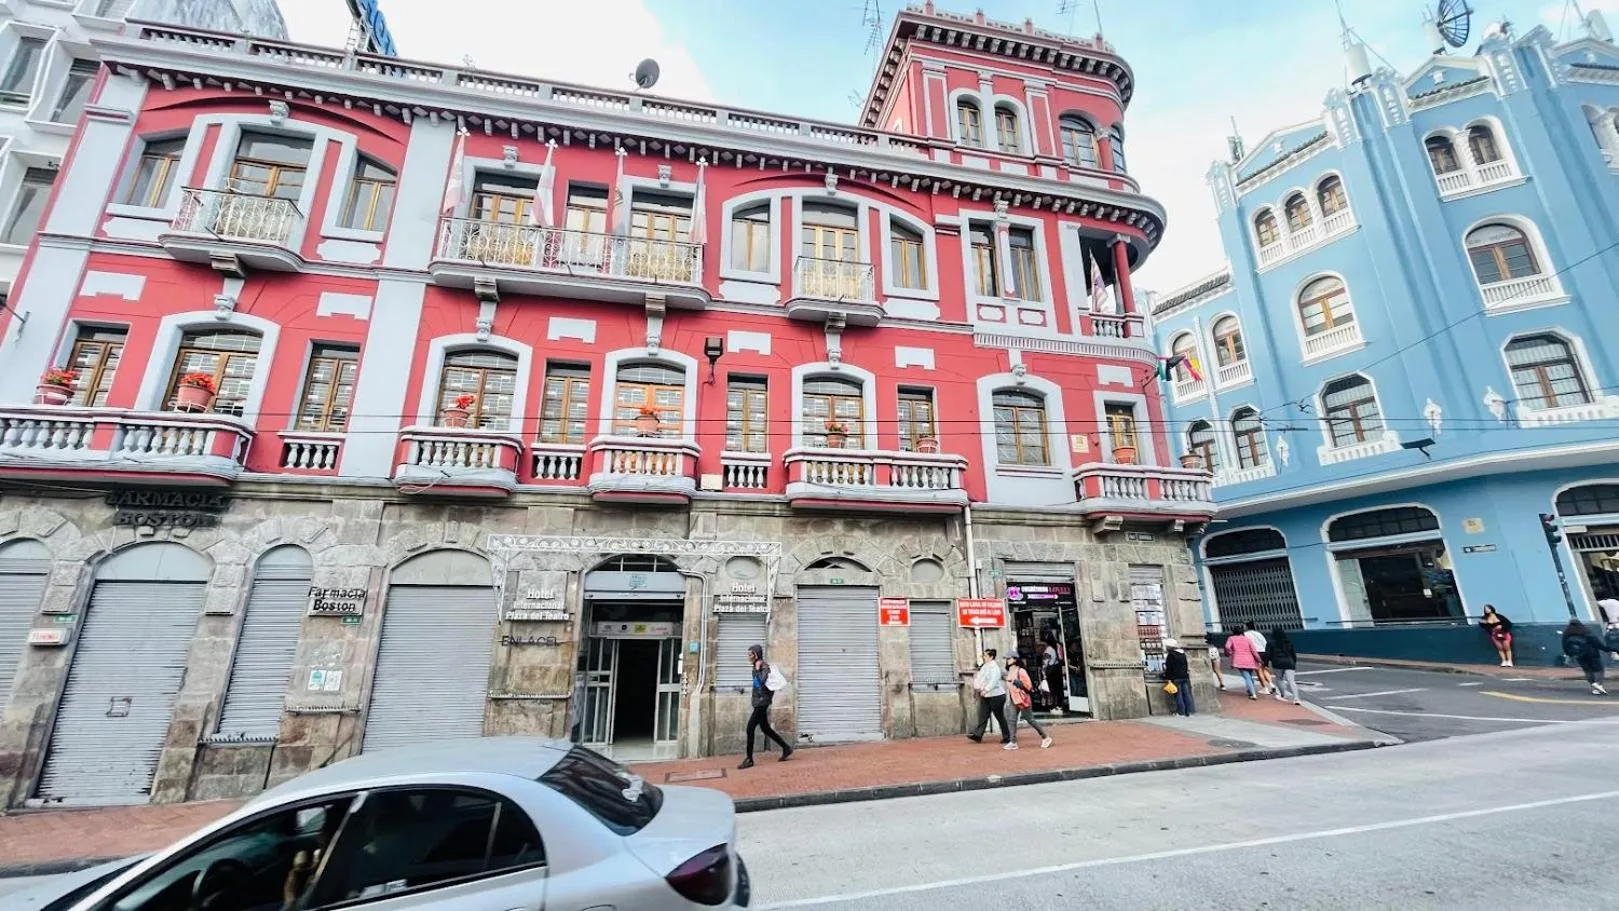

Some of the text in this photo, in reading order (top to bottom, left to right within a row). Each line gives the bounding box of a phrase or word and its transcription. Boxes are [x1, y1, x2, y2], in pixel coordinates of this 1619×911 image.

[308, 587, 366, 599] Farmacia
[527, 588, 554, 598] Hotel
[731, 584, 755, 592] Hotel
[313, 599, 356, 611] Boston
